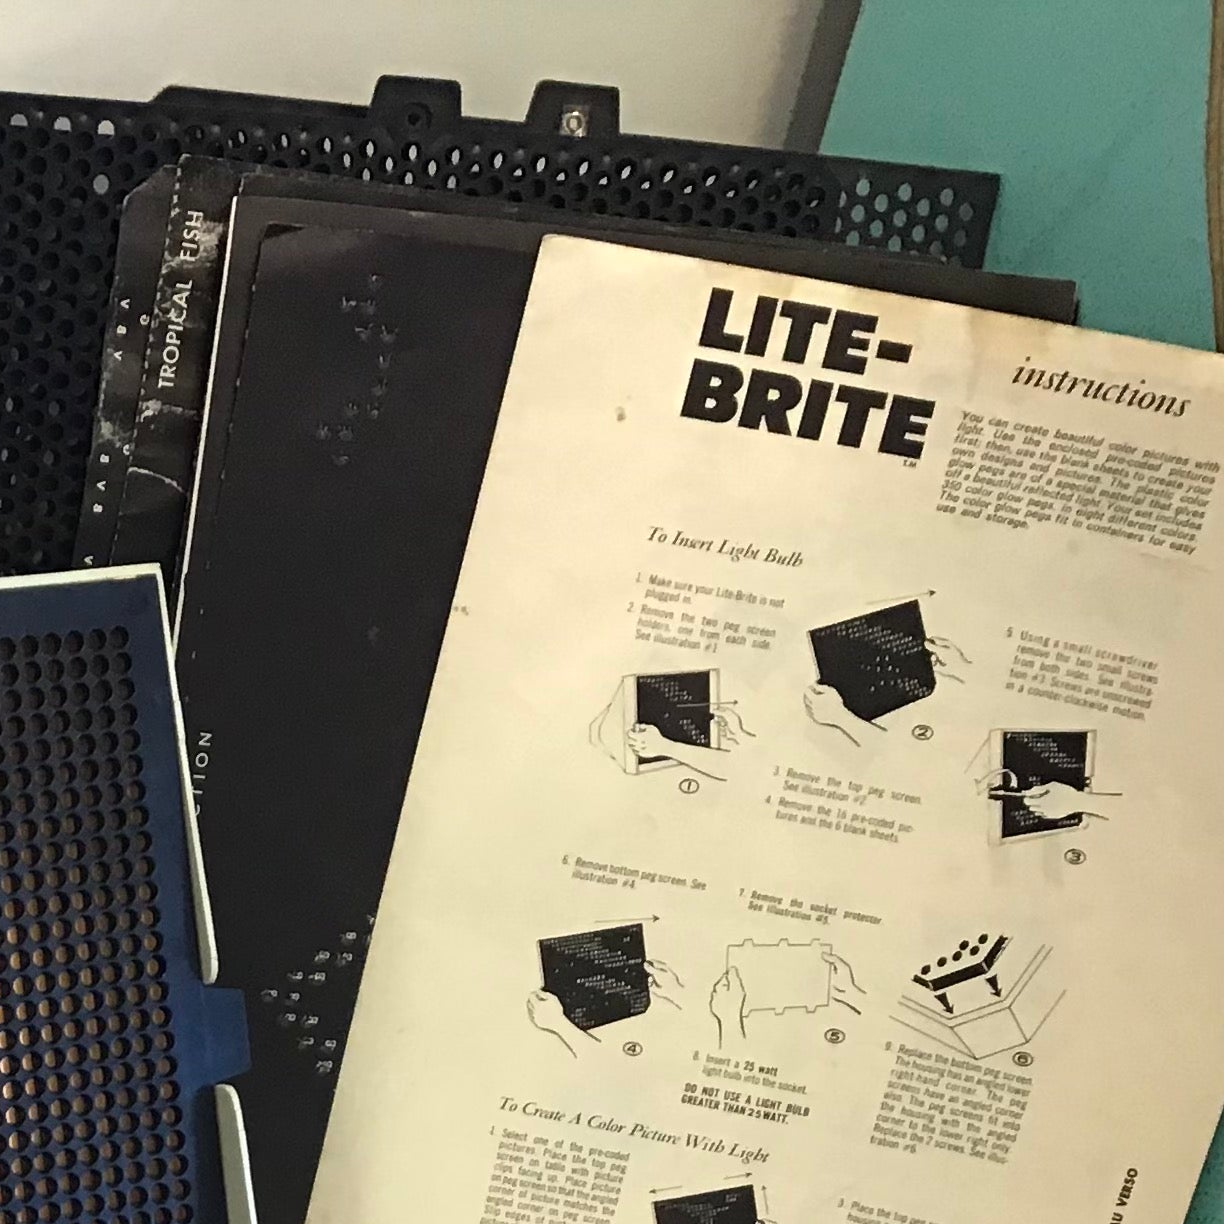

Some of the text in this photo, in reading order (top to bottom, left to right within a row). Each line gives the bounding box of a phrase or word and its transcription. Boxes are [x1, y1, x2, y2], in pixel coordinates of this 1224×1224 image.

[158, 209, 204, 389] TROPICAL FISH
[699, 287, 913, 375] LITE-
[680, 358, 936, 459] BRITE
[1011, 355, 1192, 417] instructions
[962, 411, 984, 423] You
[1014, 424, 1049, 437] create
[1053, 429, 1104, 447] beautiful
[1142, 450, 1189, 466] pictures
[648, 527, 802, 567] To Insert Light Bulb
[681, 1094, 720, 1110] GREATER
[702, 1087, 719, 1097] NOT
[500, 1098, 769, 1164] To Create A Color Picture With Light
[1116, 1168, 1137, 1206] VERSO
